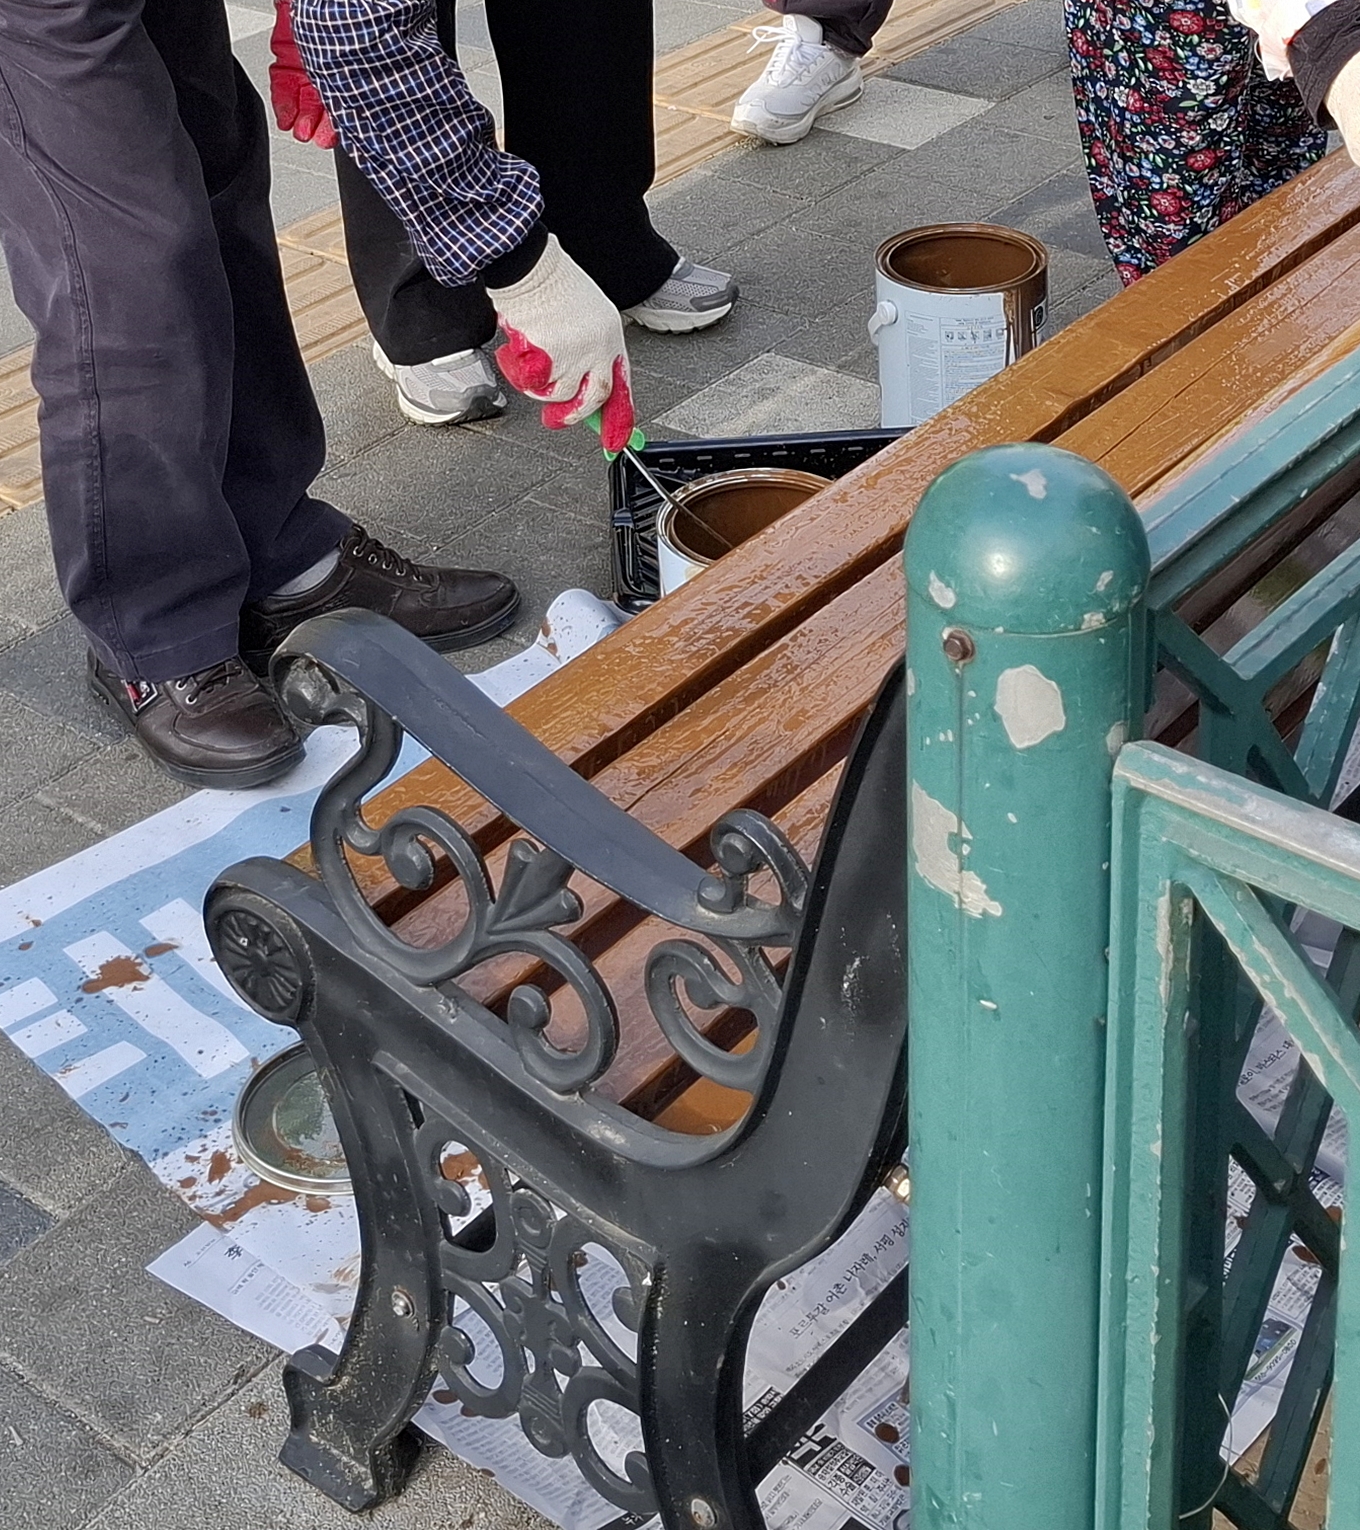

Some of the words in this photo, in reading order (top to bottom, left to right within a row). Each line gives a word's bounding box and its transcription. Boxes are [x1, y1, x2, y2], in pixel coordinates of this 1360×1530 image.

[789, 1303, 831, 1339] 포르투갈
[825, 1282, 849, 1304] 어촌
[873, 1234, 895, 1257] 서핑
